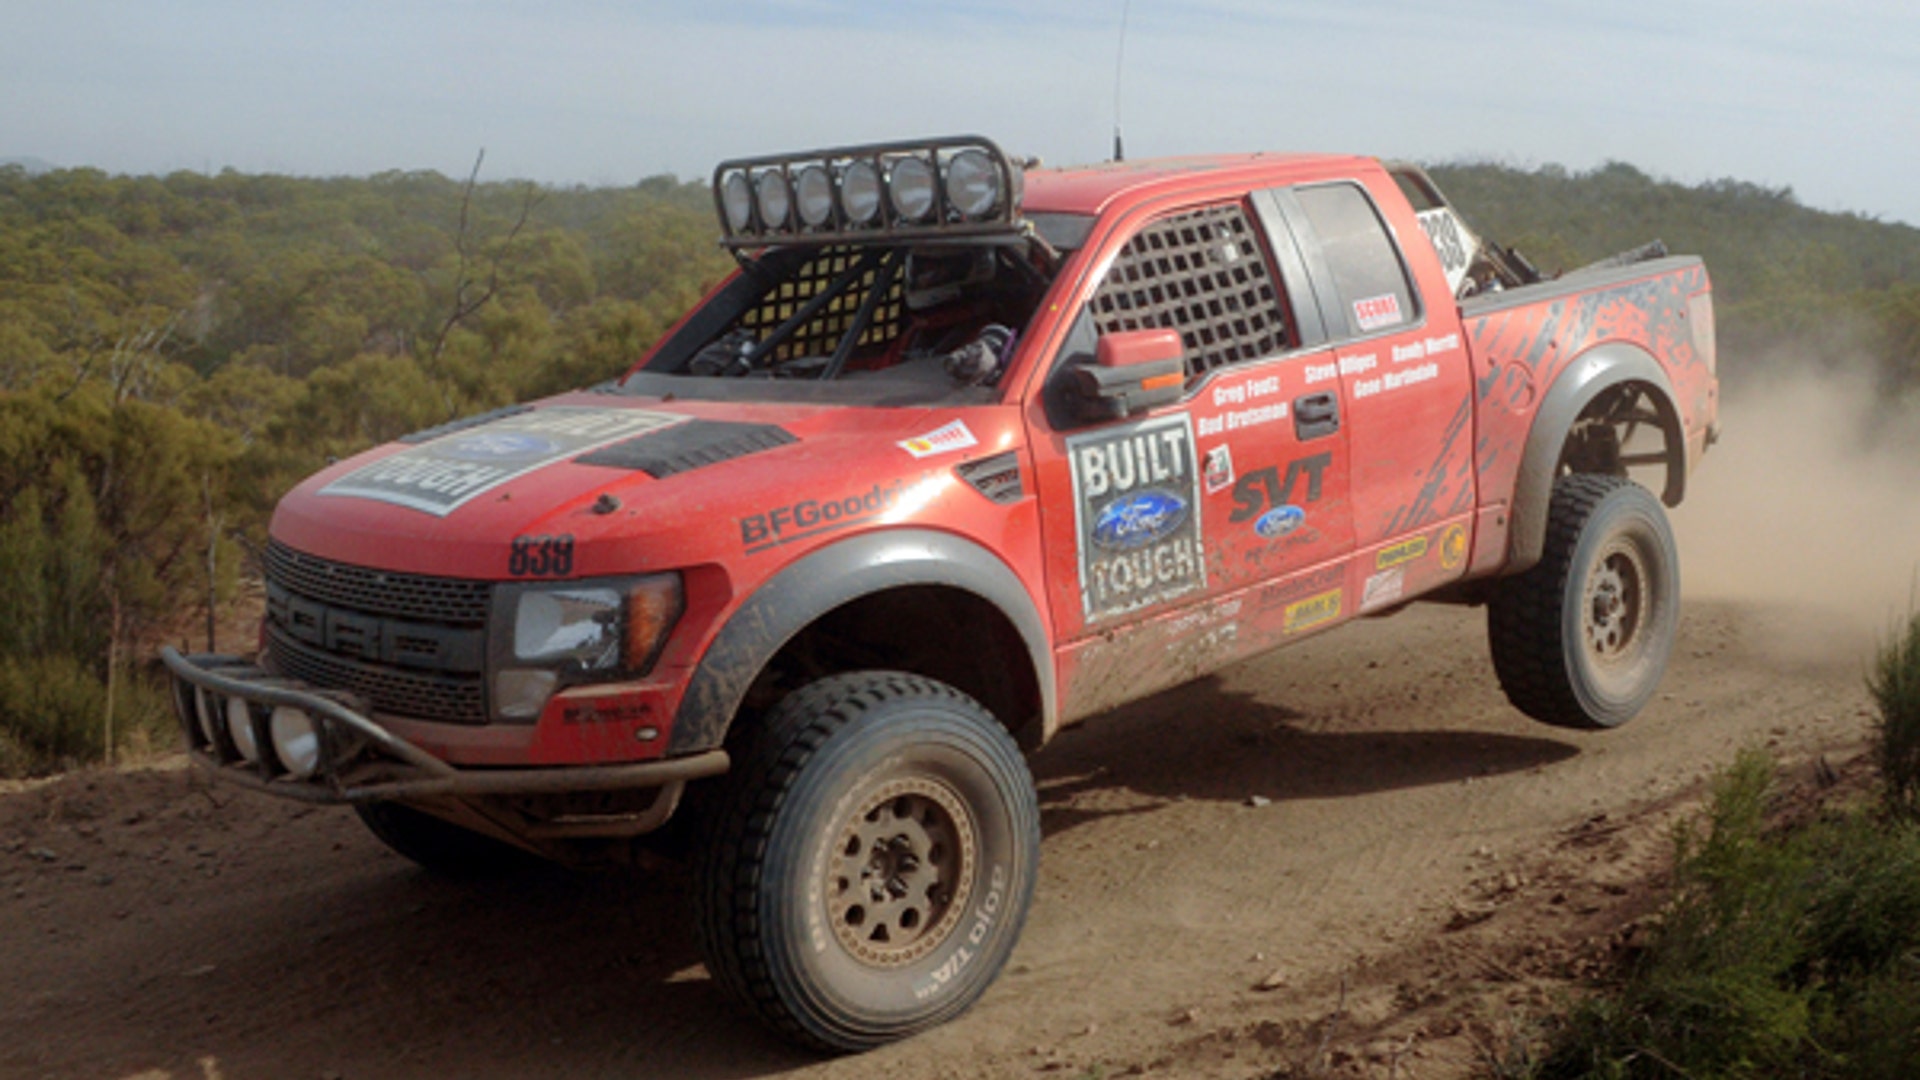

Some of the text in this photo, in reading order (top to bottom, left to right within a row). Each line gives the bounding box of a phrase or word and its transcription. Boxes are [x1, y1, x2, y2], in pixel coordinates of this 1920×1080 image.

[1080, 428, 1184, 497] BUILT
[1228, 450, 1333, 523] SVT
[509, 533, 574, 576] 838
[1091, 538, 1194, 600] TOUGH
